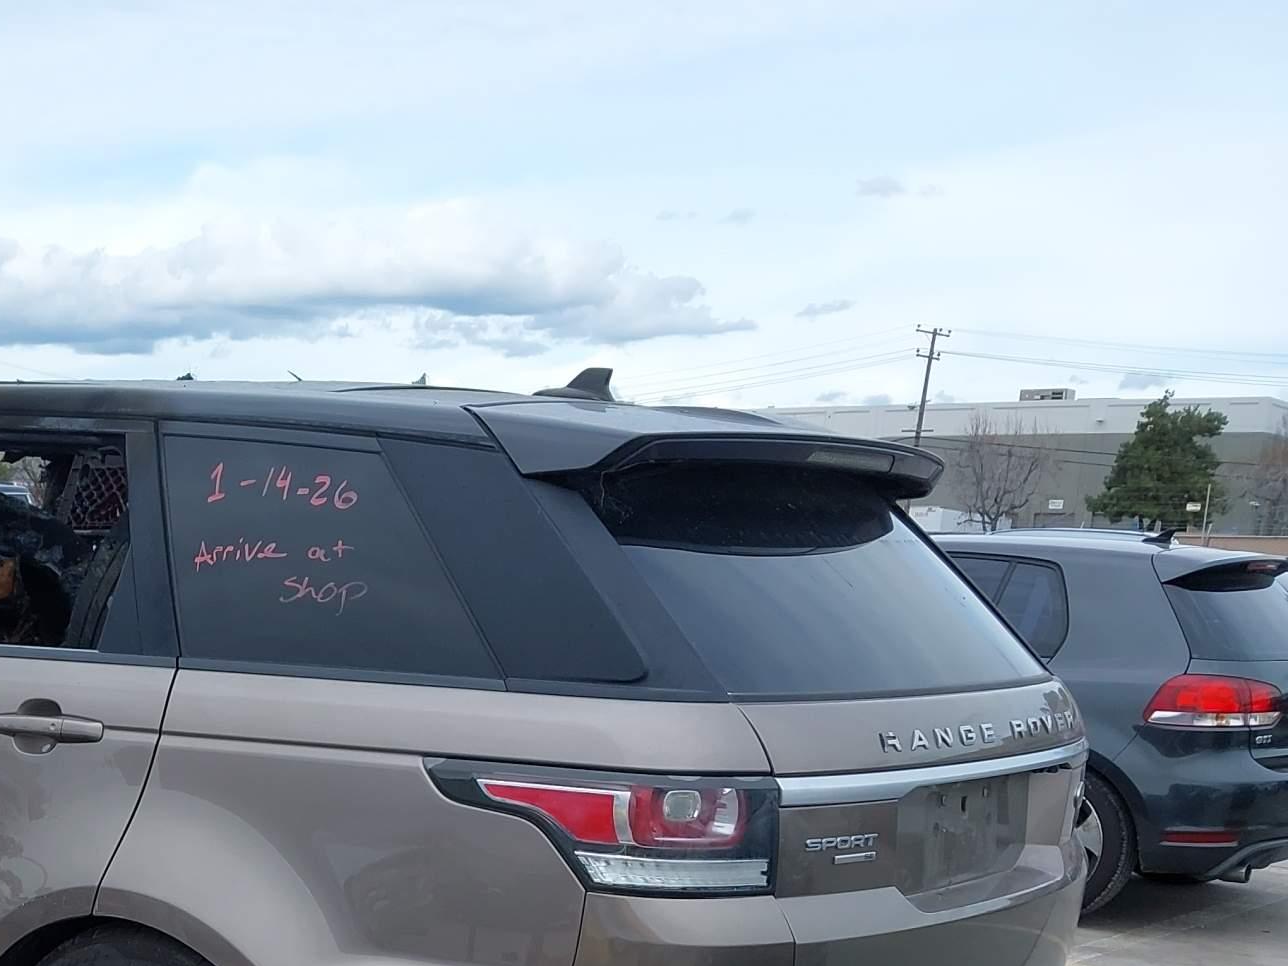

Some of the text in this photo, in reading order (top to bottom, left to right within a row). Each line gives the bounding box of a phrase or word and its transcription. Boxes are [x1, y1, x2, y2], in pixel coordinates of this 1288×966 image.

[194, 537, 355, 572] Arrive at
[879, 710, 1075, 753] RANGE ROVER
[805, 833, 879, 852] SPORT
